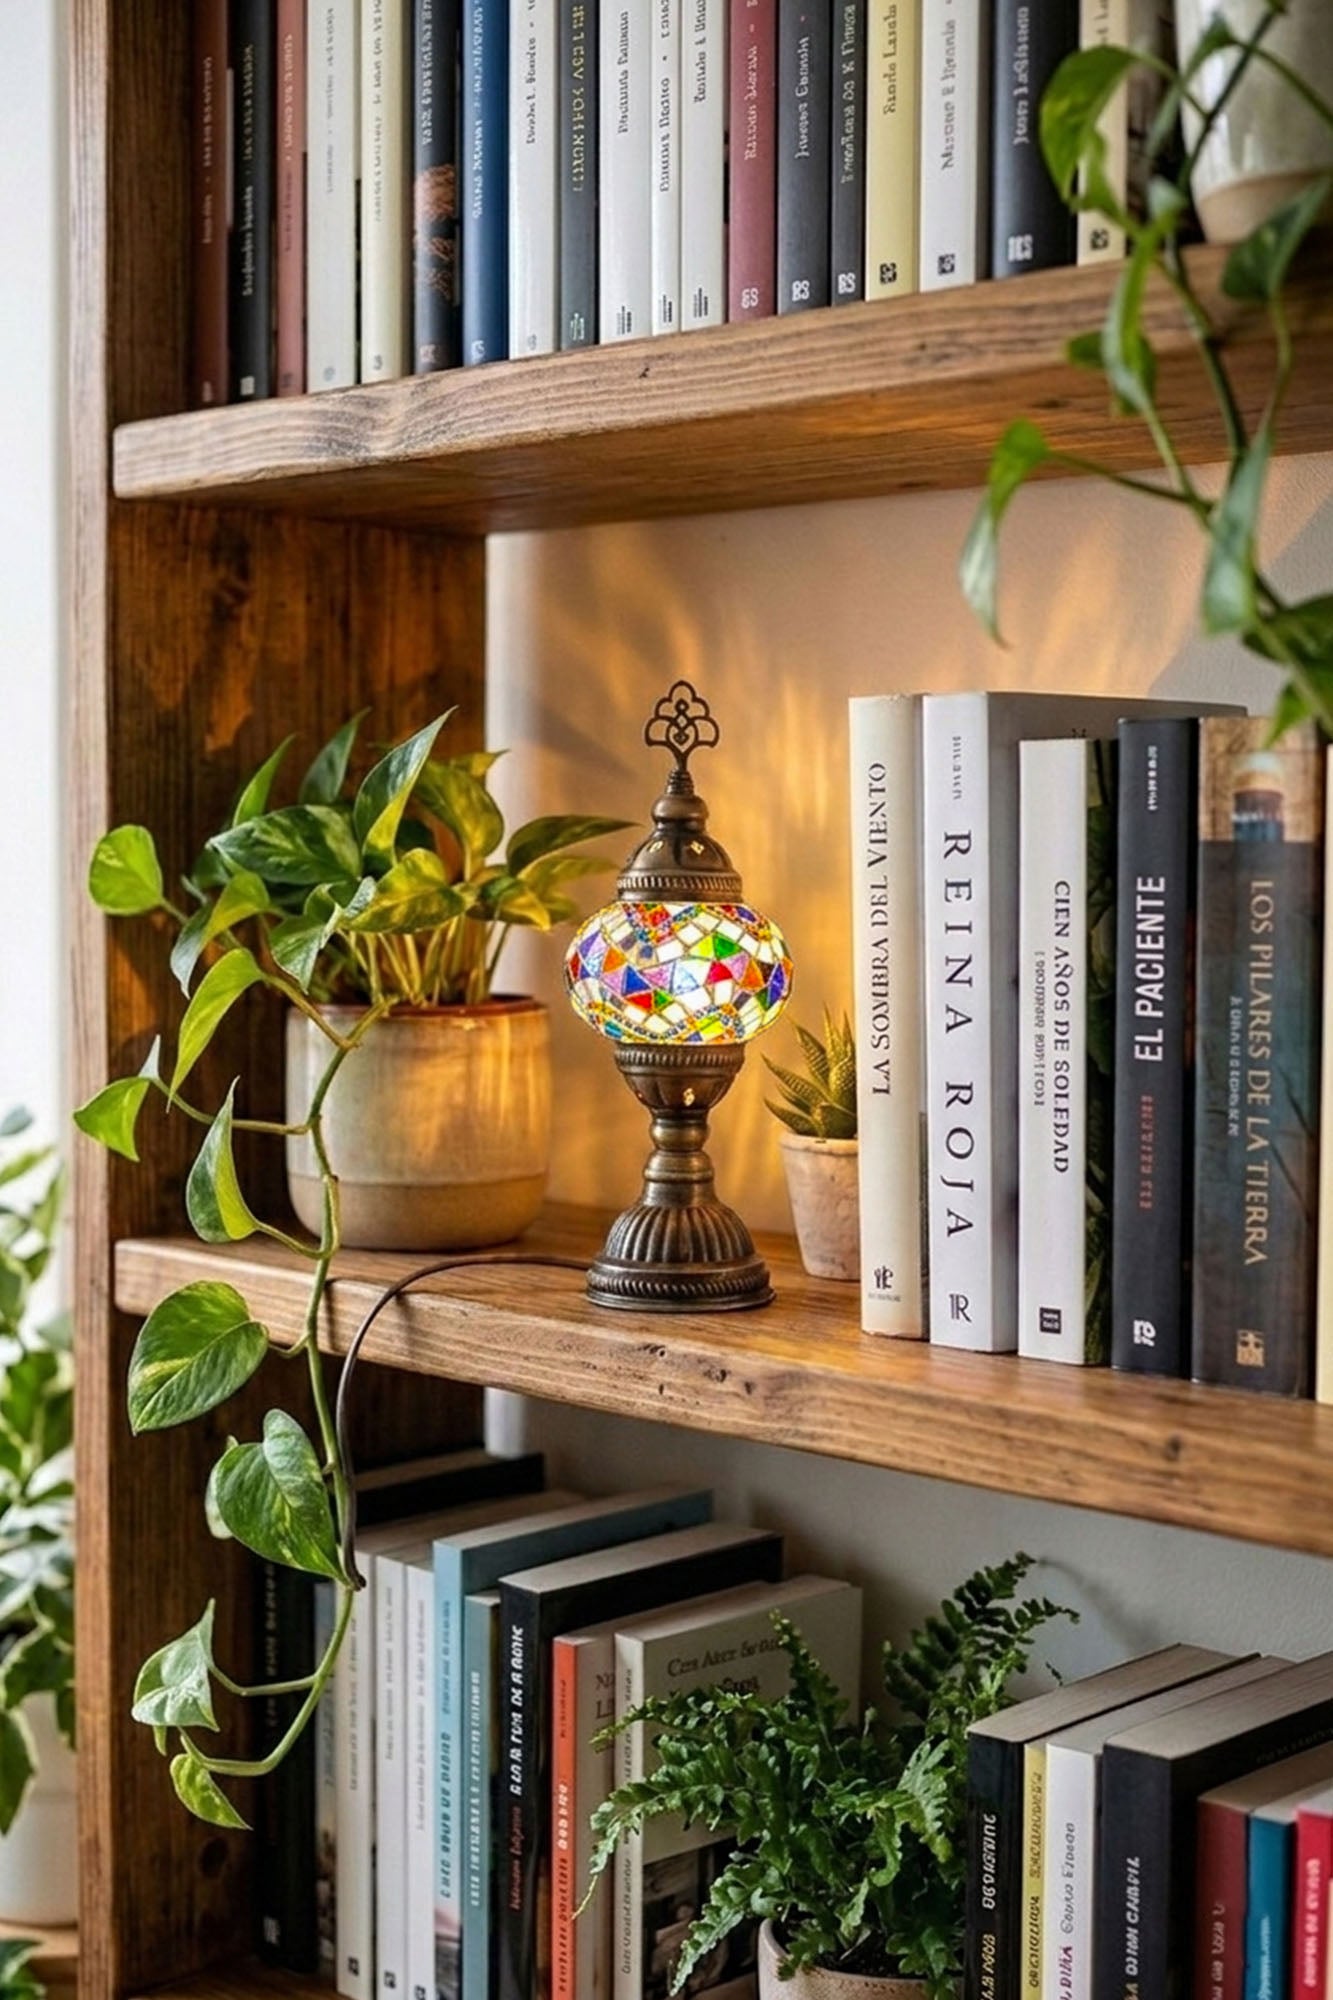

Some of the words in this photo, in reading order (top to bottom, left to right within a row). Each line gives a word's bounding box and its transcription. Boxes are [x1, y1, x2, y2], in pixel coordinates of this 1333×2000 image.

[868, 764, 887, 867] VIENTO
[871, 876, 888, 926] DEL
[944, 832, 972, 1033] REINA
[1055, 881, 1070, 937] CIEN
[1248, 881, 1273, 933] LOS
[1055, 947, 1073, 1010] AÑOS
[1136, 878, 1164, 1017] PACIENTE
[872, 938, 889, 1049] SOMBRA
[1249, 945, 1273, 1058] PILARES
[1055, 1021, 1069, 1050] DE
[1135, 1029, 1163, 1060] EL
[873, 1059, 890, 1094] LA
[1248, 1070, 1270, 1104] DE
[1054, 1061, 1069, 1172] SOLEDAD
[1247, 1117, 1270, 1150] LA
[941, 1082, 974, 1237] ROJA
[1245, 1161, 1268, 1264] TIERRA
